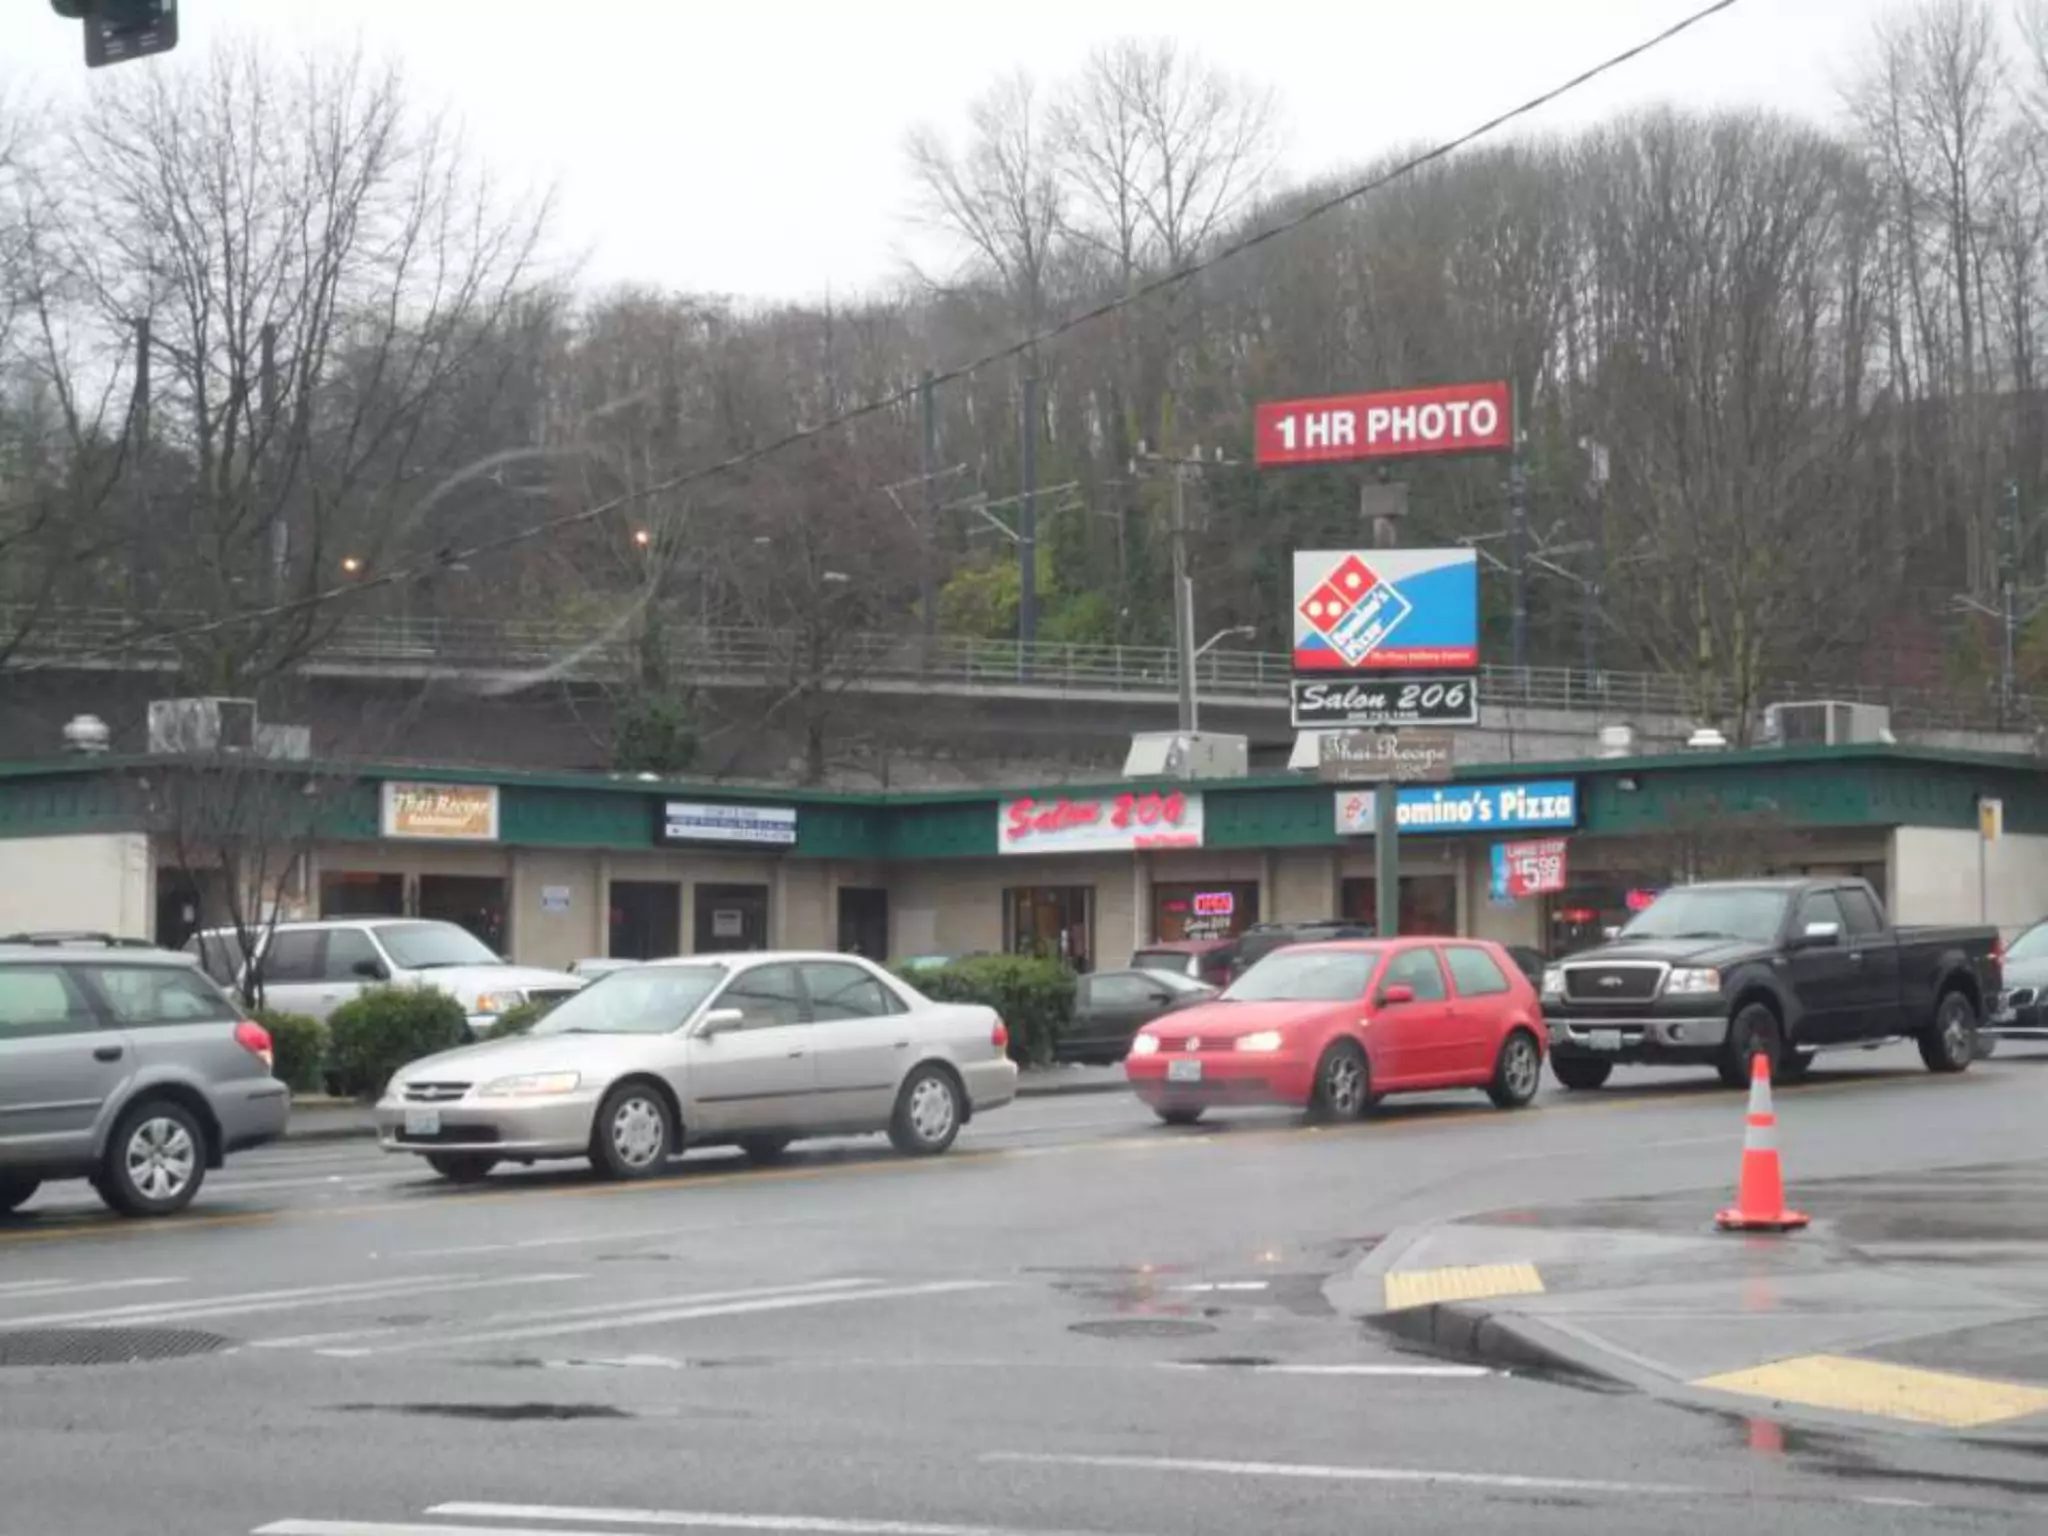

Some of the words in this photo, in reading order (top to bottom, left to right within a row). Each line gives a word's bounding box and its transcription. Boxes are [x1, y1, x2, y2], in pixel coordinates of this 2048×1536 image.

[1276, 415, 1296, 449] 1
[1305, 410, 1355, 447] HR
[1367, 398, 1498, 443] PHOTO
[1299, 684, 1386, 710] Salon
[1398, 684, 1466, 708] 206
[1396, 792, 1492, 825] omino's
[1499, 788, 1574, 819] Pizza
